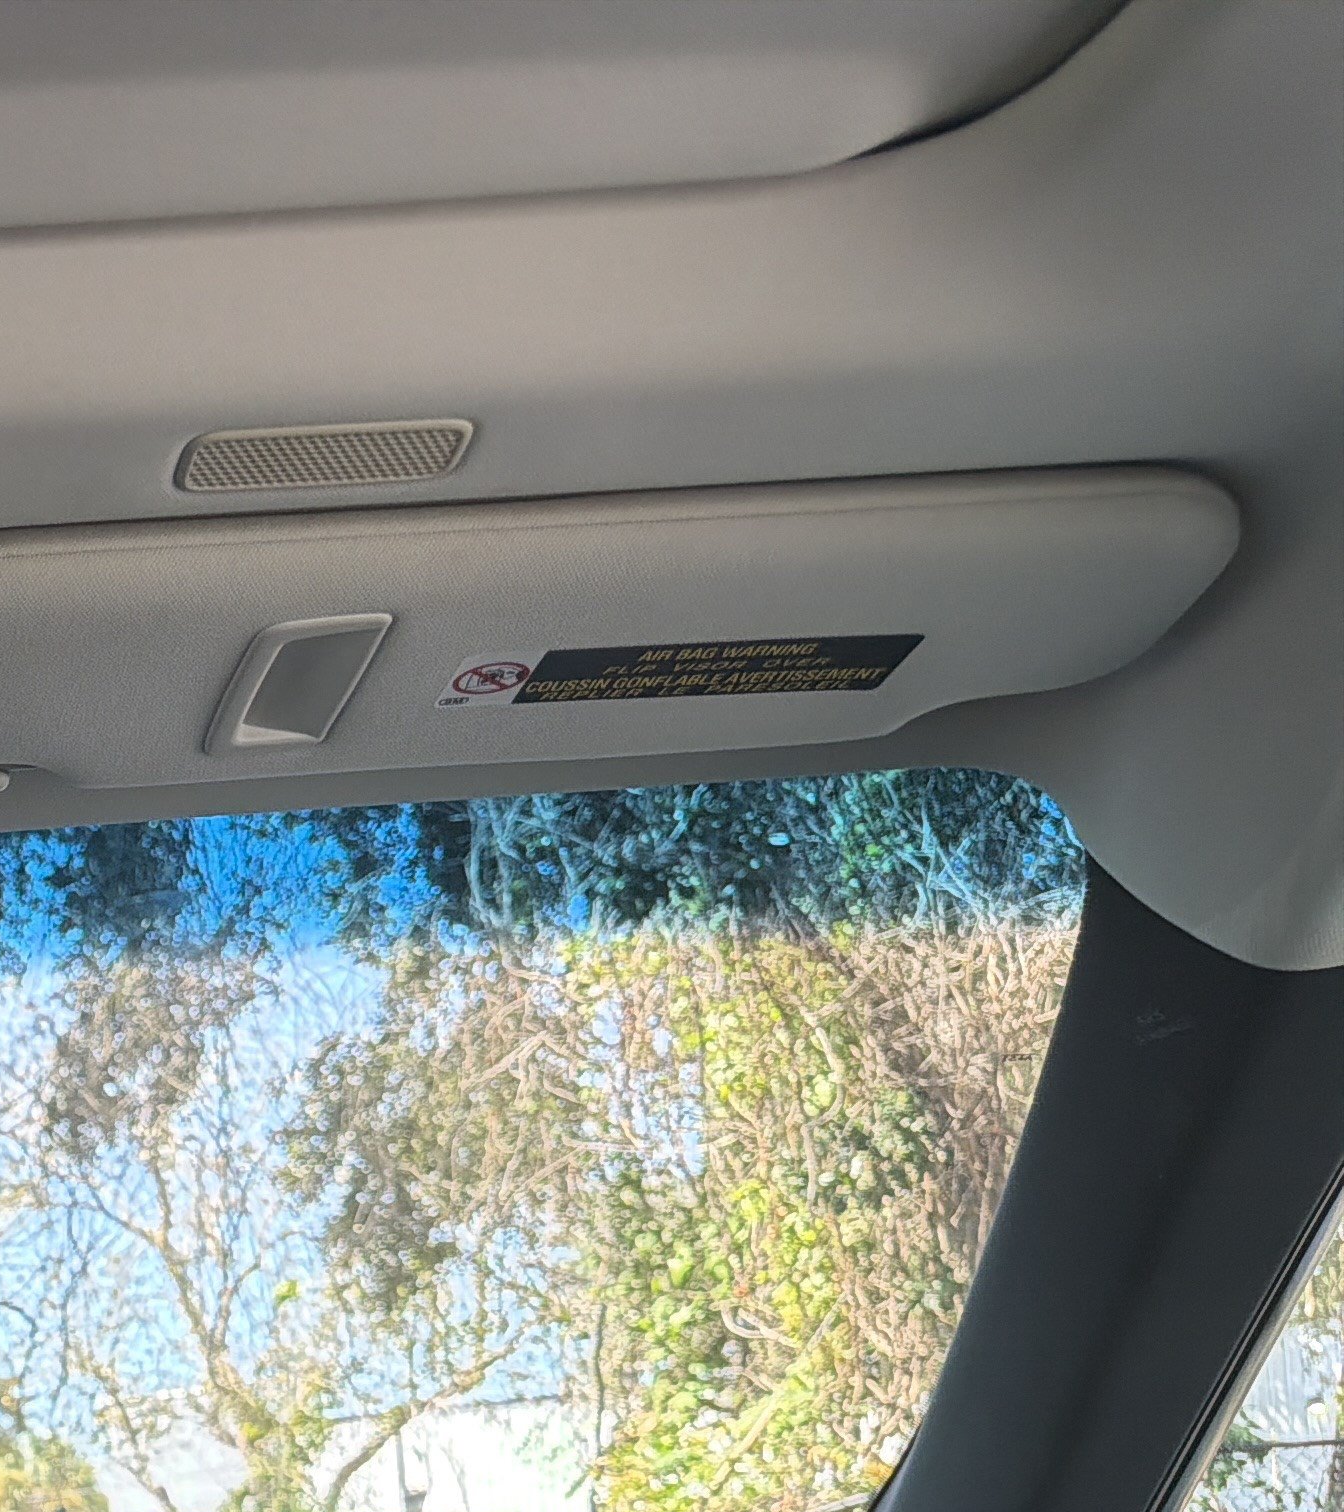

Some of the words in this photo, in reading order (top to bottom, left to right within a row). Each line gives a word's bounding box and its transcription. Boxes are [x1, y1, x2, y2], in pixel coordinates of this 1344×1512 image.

[639, 649, 673, 662] AIR
[675, 646, 718, 661] BAG
[722, 642, 820, 658] WARNING
[603, 664, 658, 676] FLIP
[673, 660, 748, 673] VISOR
[762, 657, 831, 669] OVER
[525, 678, 610, 694] COUSSIN
[612, 673, 726, 690] GONFLABLE
[726, 667, 889, 685] AVERTISSEMENT
[540, 688, 644, 701] REPLIER
